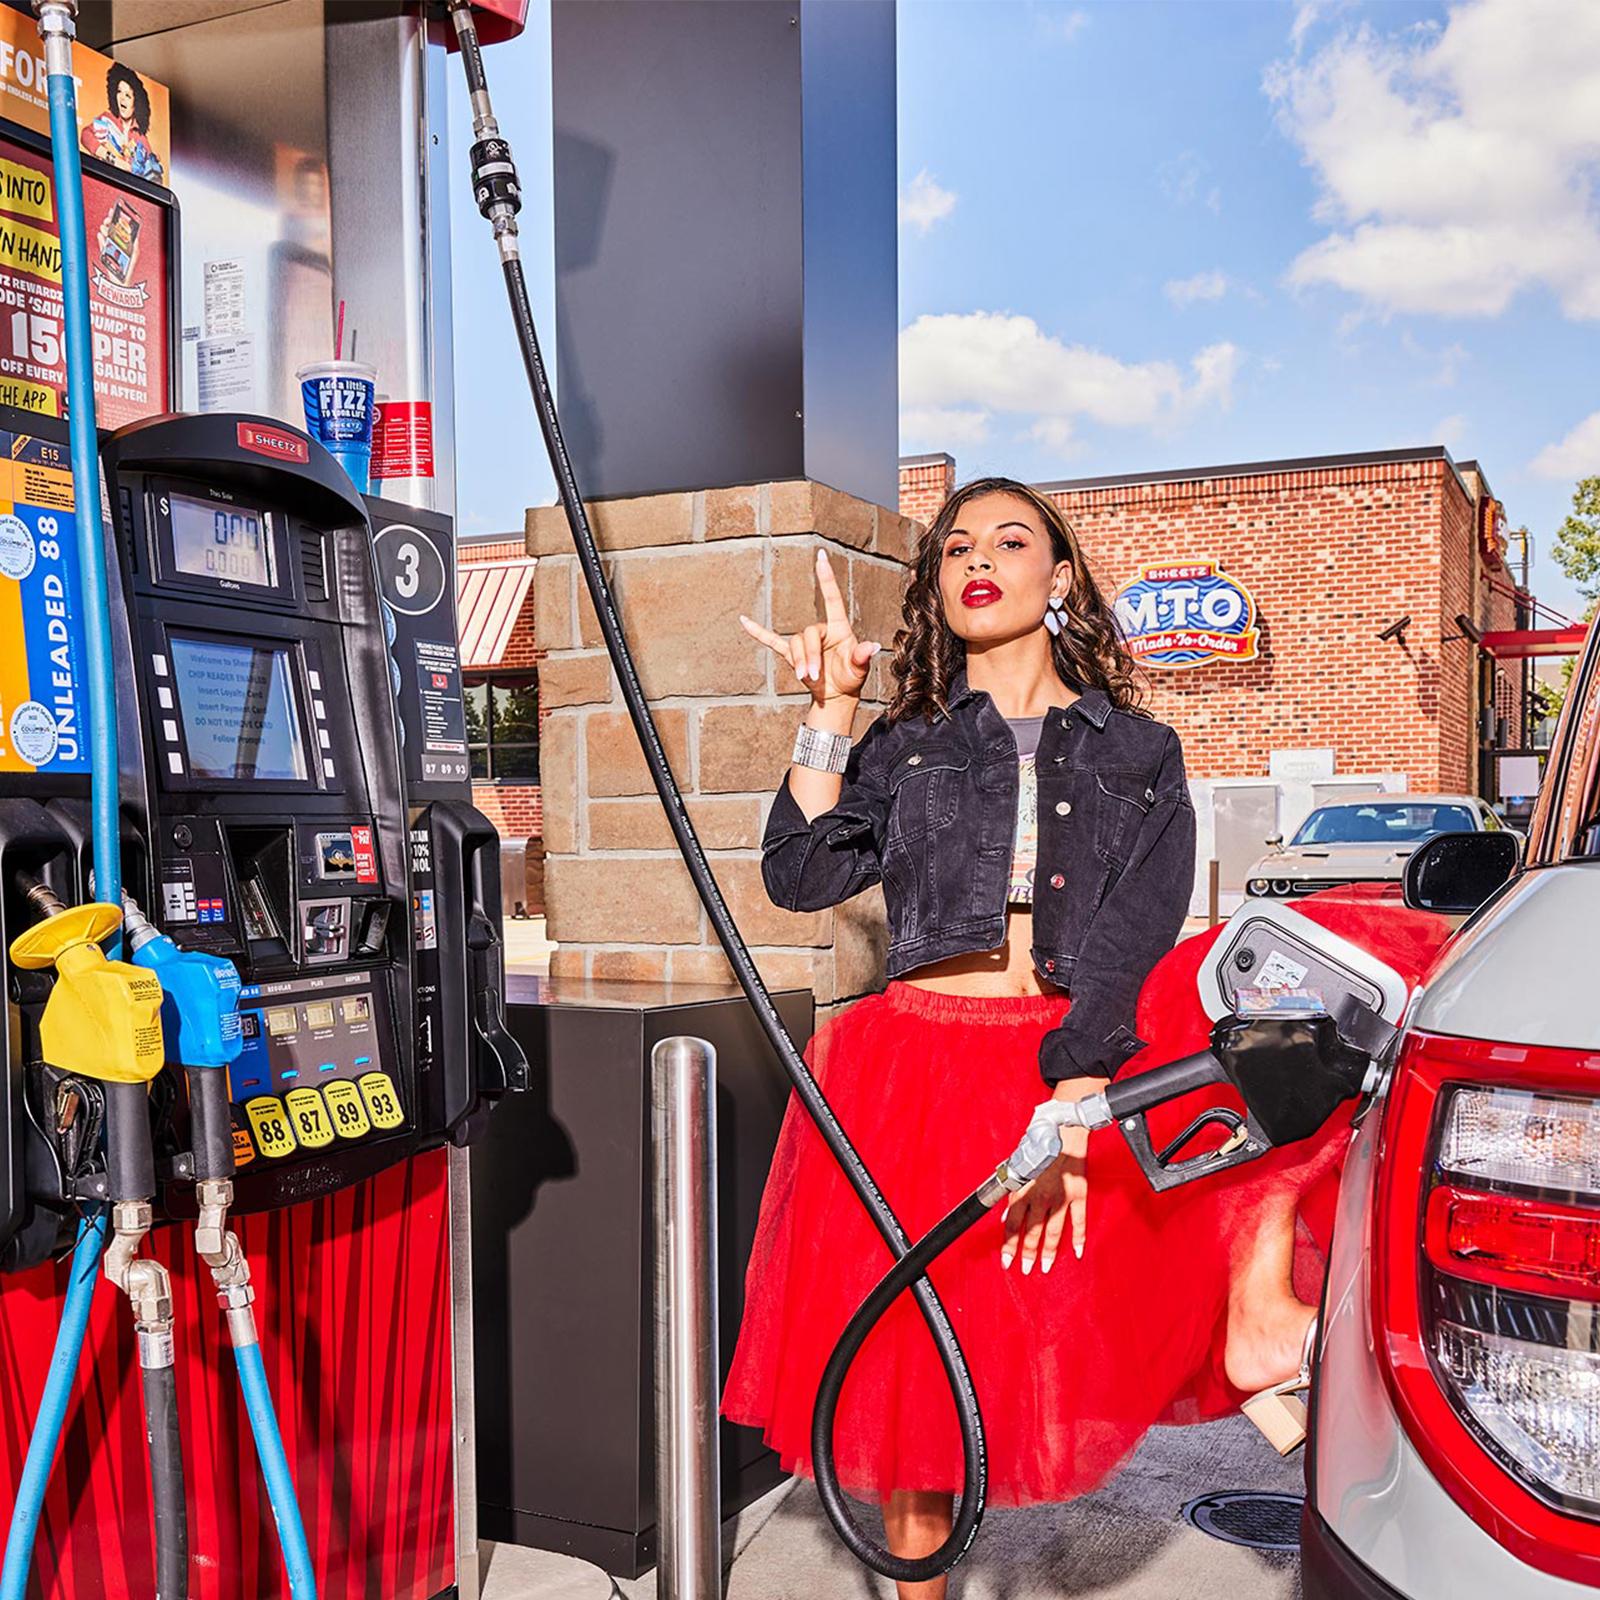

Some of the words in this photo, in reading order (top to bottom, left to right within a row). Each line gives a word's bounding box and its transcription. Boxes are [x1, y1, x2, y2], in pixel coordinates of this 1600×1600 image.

[7, 175, 45, 206] INTO
[94, 332, 147, 373] PER
[1, 359, 24, 374] OFF
[26, 364, 63, 384] EVERY
[94, 361, 148, 387] GALLON
[22, 389, 47, 410] APP
[319, 389, 366, 411] FIZZ
[40, 446, 59, 461] E15
[255, 433, 296, 453] SHEETZ
[160, 497, 169, 516] $
[38, 515, 60, 560] 88
[395, 543, 420, 598] 3
[1148, 566, 1208, 580] SHEETZ
[44, 574, 79, 761] UNLEADED
[425, 763, 436, 774] 87
[455, 764, 466, 775] 93
[128, 978, 159, 991] WARNING
[336, 1101, 360, 1125] 89
[371, 1093, 394, 1116] 93
[259, 1118, 286, 1143] 88
[299, 1110, 321, 1134] 87
